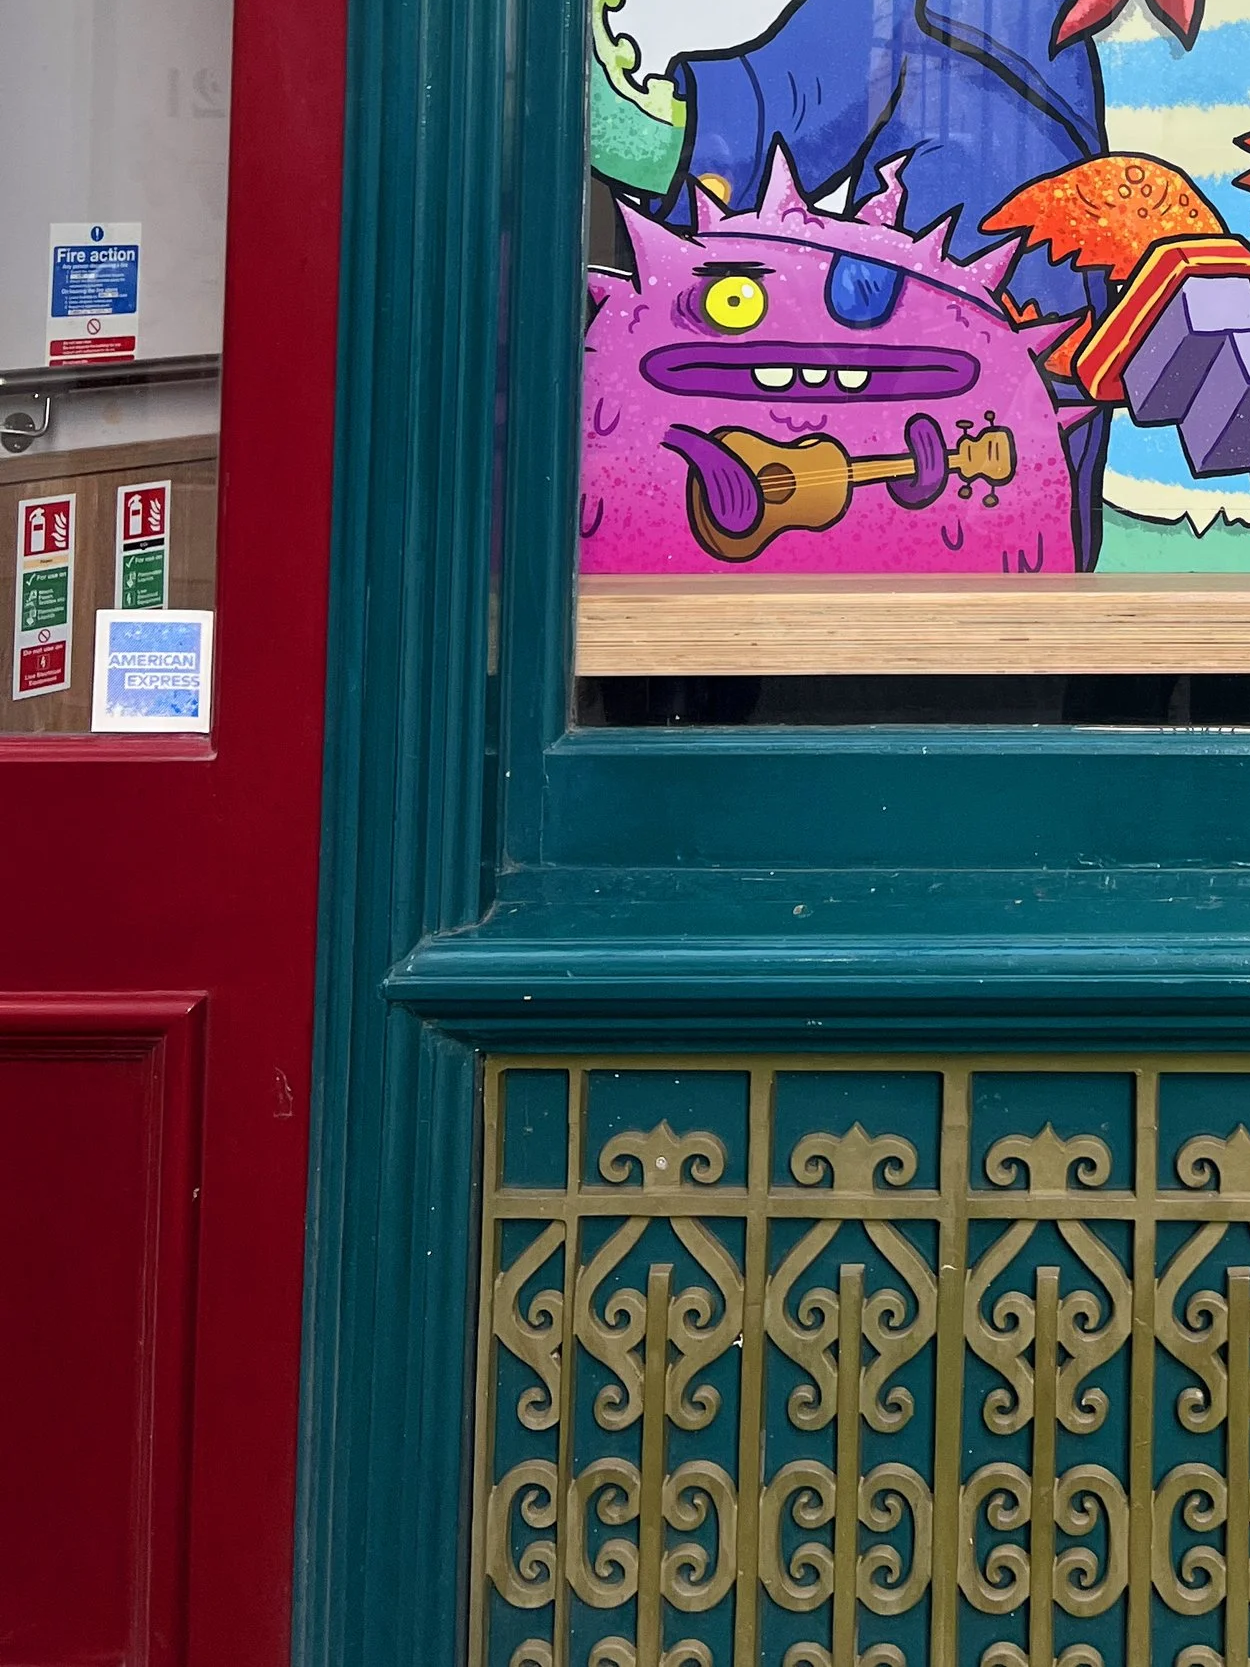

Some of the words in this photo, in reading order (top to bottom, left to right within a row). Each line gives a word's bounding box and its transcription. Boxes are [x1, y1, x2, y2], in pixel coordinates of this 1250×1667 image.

[57, 248, 86, 263] Fire
[90, 246, 136, 263] action
[109, 654, 194, 667] AMERICAN
[127, 675, 201, 687] EXPRESS
